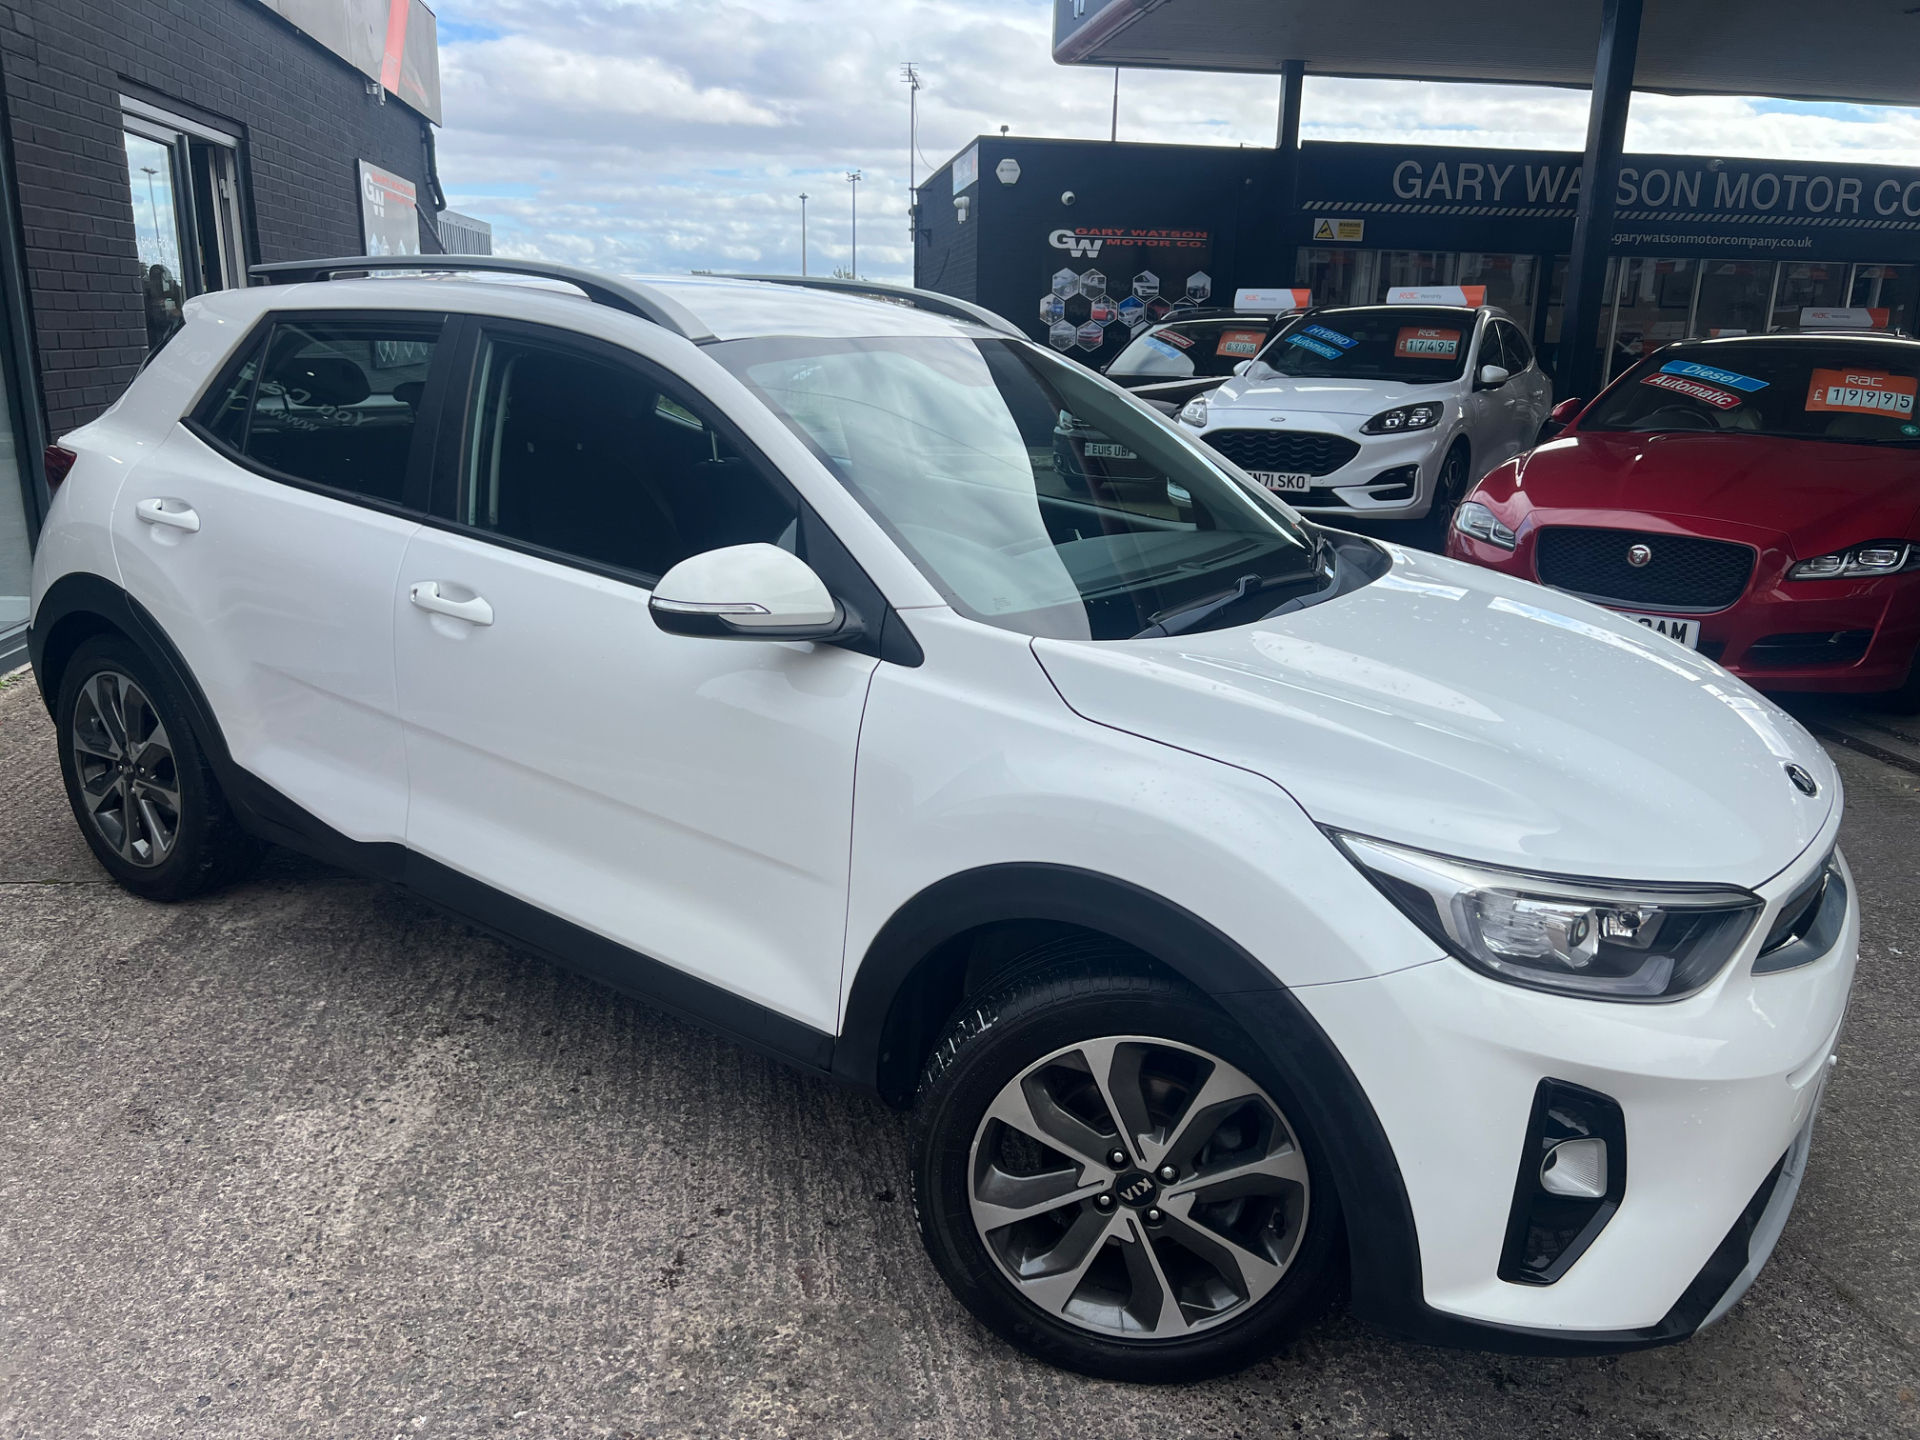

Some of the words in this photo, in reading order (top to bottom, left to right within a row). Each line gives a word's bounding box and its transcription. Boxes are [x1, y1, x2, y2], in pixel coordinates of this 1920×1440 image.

[1392, 160, 1515, 201] GARY
[1525, 165, 1702, 208] WASON
[1713, 172, 1863, 214] MOTOR
[1873, 179, 1920, 217] CO
[1075, 227, 1125, 236] GARY
[1131, 229, 1208, 238] WATSON
[1106, 238, 1171, 247] MOTOR
[1176, 240, 1207, 248] CO.
[1310, 327, 1350, 345] HYBRID
[1291, 335, 1336, 357] Automatic
[1682, 364, 1743, 384] Diesel
[1650, 374, 1733, 405] Automatic
[1092, 444, 1112, 457] EU15
[1277, 474, 1305, 489] SKO
[1120, 1178, 1153, 1201] KIA
